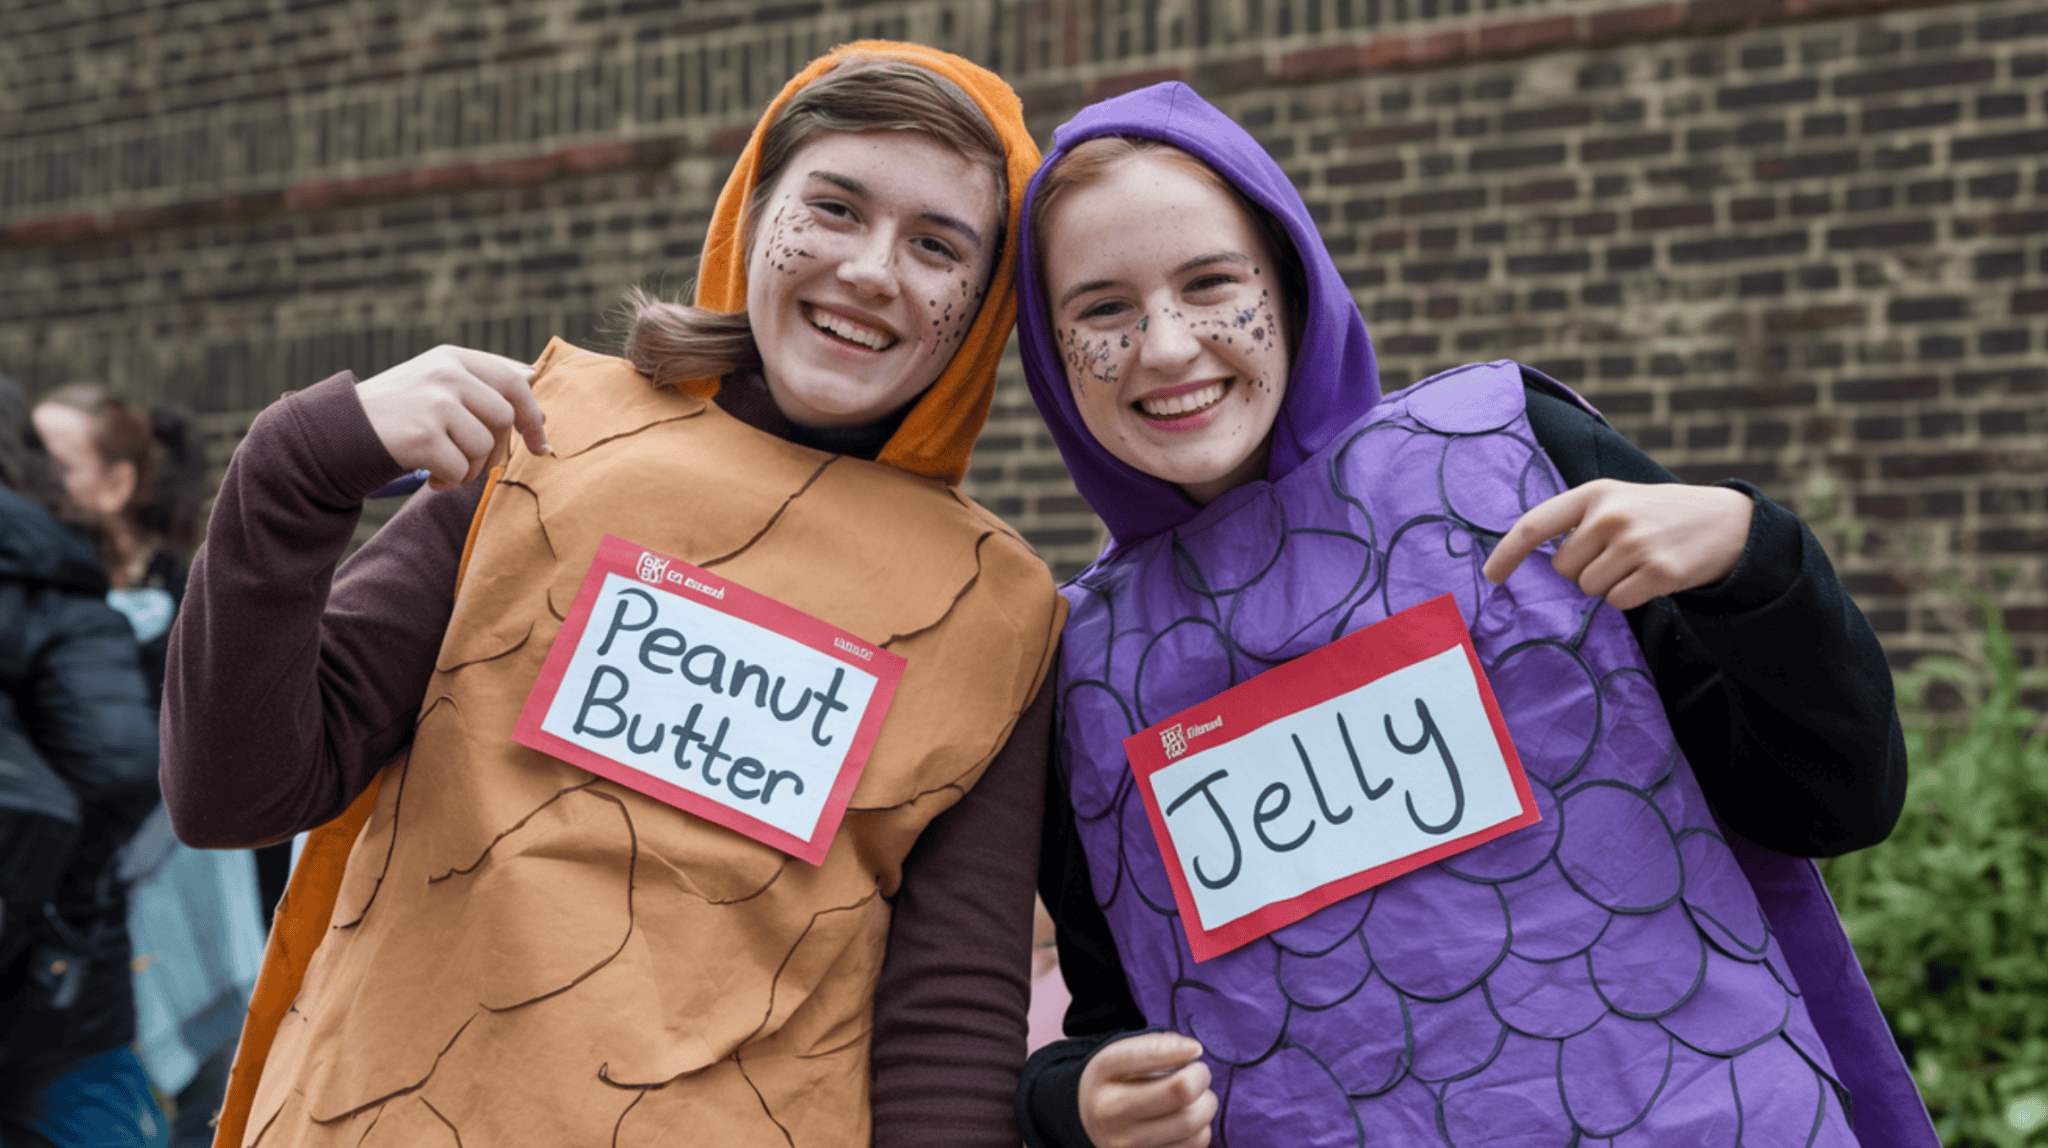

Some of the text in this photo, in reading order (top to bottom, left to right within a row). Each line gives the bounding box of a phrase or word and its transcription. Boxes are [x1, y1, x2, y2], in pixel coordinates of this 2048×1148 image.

[573, 665, 804, 804] Butter
[597, 588, 848, 747] Peanut
[1166, 698, 1465, 890] Jelly
